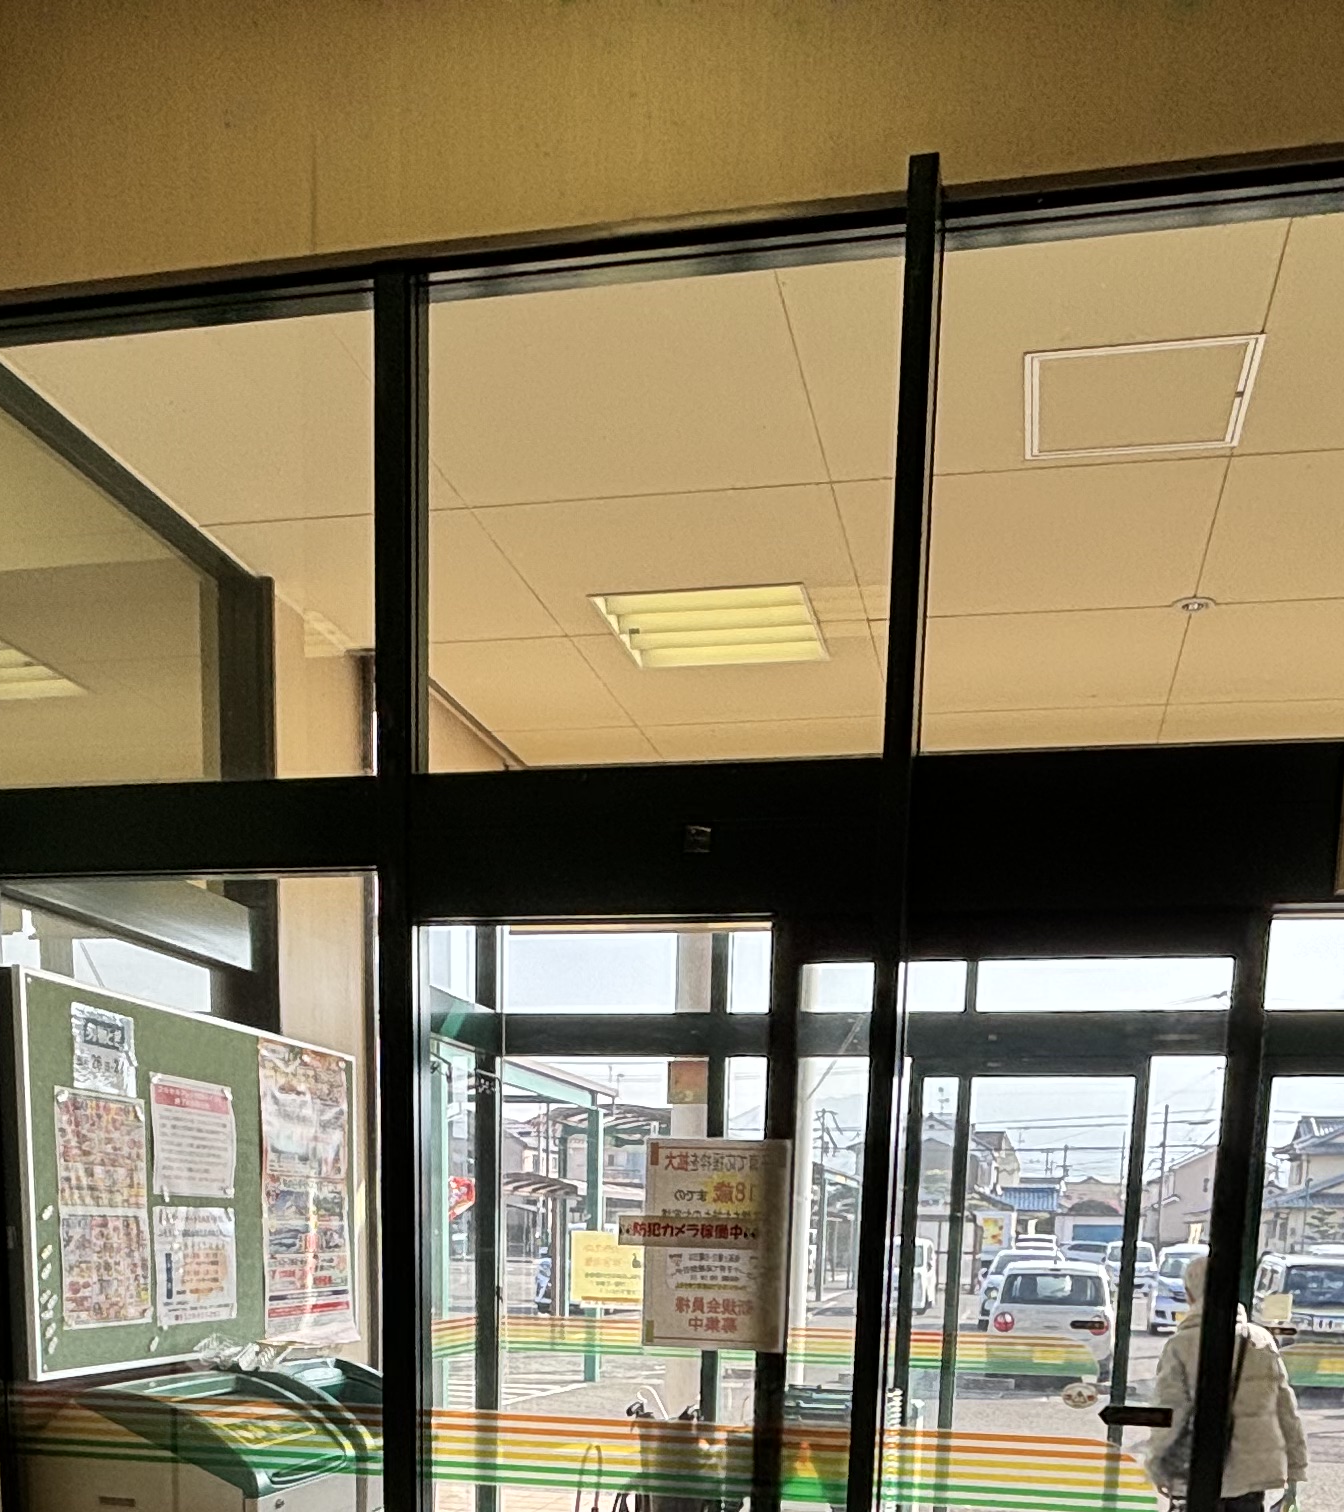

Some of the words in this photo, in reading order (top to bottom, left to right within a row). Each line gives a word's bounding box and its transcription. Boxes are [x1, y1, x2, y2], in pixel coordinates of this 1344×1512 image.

[632, 1222, 743, 1240] 防犯カメラ稼働中
